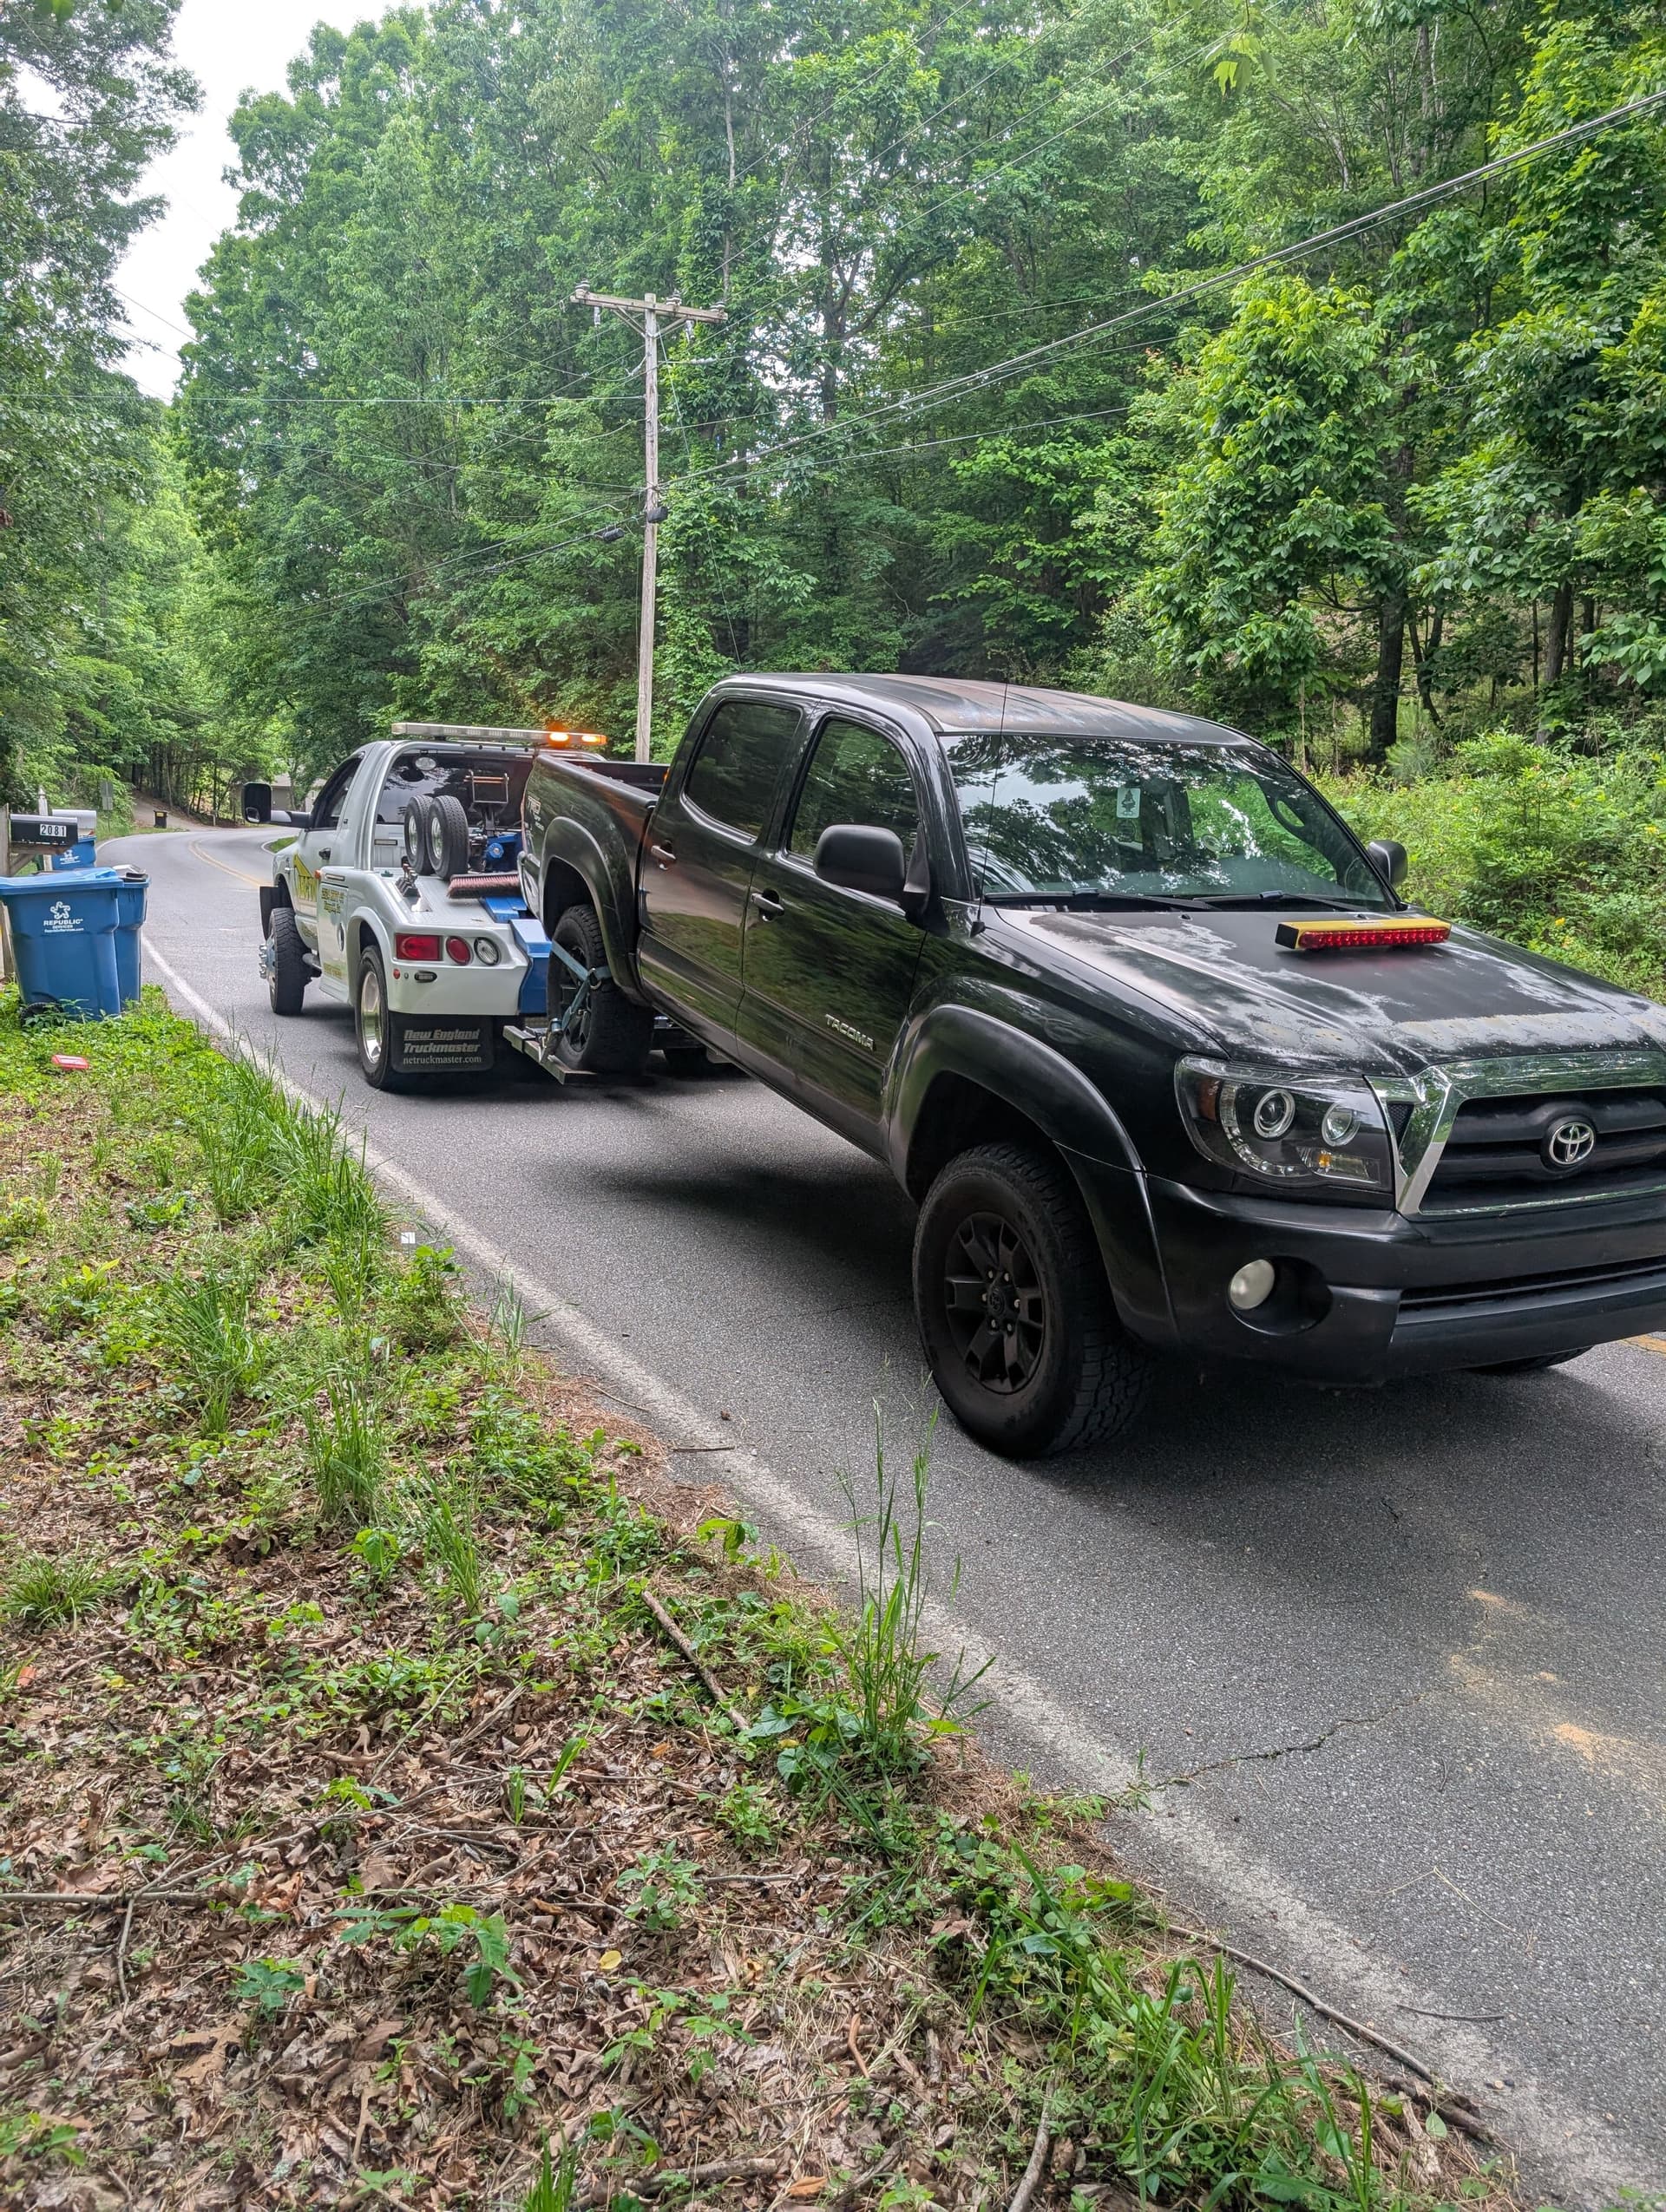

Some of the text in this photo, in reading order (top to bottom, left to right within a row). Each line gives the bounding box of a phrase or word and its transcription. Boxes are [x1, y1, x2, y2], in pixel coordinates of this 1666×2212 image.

[41, 825, 65, 836] 2081
[403, 1029, 481, 1041] New England
[825, 1014, 874, 1050] TACOMA
[403, 1043, 481, 1053] Truckmaster
[403, 1056, 482, 1064] netruckmaster.com
